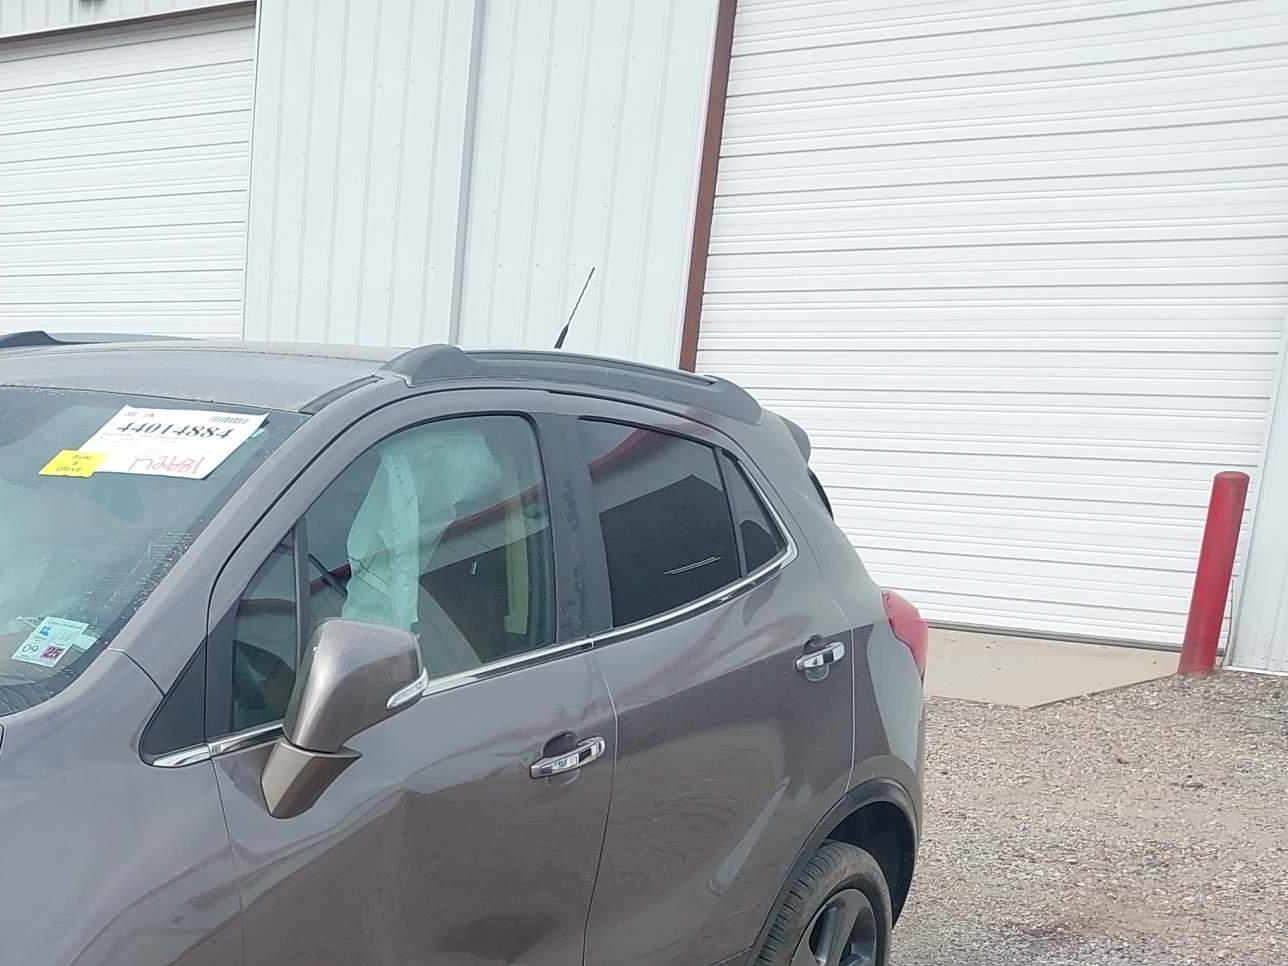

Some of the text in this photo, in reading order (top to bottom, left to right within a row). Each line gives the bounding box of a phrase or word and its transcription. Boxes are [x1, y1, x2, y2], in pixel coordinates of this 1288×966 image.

[117, 421, 235, 440] 44014884
[22, 643, 40, 654] 09
[43, 646, 65, 659] 25
